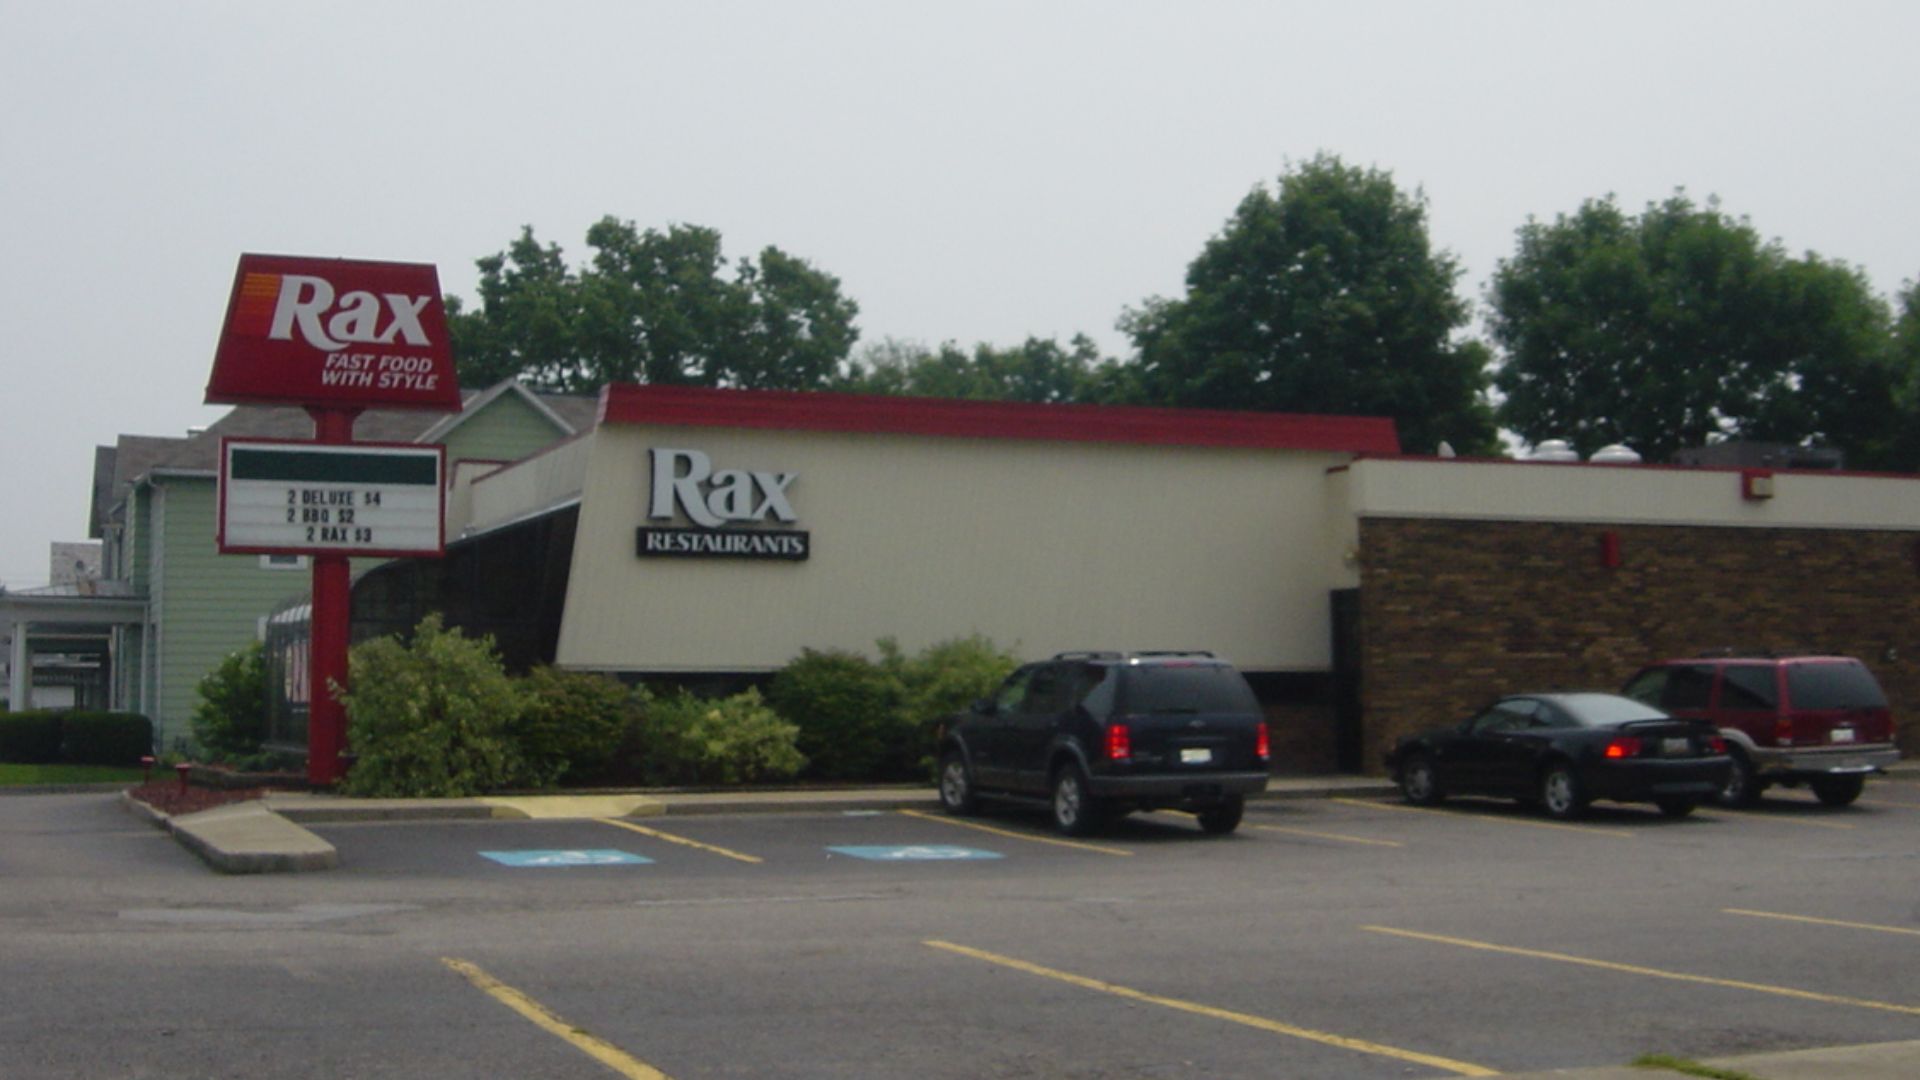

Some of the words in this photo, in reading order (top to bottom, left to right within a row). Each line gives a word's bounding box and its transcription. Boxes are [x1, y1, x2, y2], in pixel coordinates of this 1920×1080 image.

[268, 274, 432, 351] Rax
[325, 353, 376, 370] FAST
[378, 355, 433, 373] FOOD
[321, 370, 373, 386] WITH
[378, 372, 439, 390] STYLE
[648, 447, 799, 528] Rax
[288, 490, 296, 504] 2
[302, 490, 354, 505] DELUXE
[364, 491, 381, 506] $4
[287, 508, 296, 523] 2
[303, 508, 329, 523] BBQ
[338, 509, 355, 524] $2
[307, 527, 315, 542] 2
[321, 528, 348, 542] RAX
[355, 528, 372, 543] $3
[647, 532, 804, 554] RESTAURANTS
